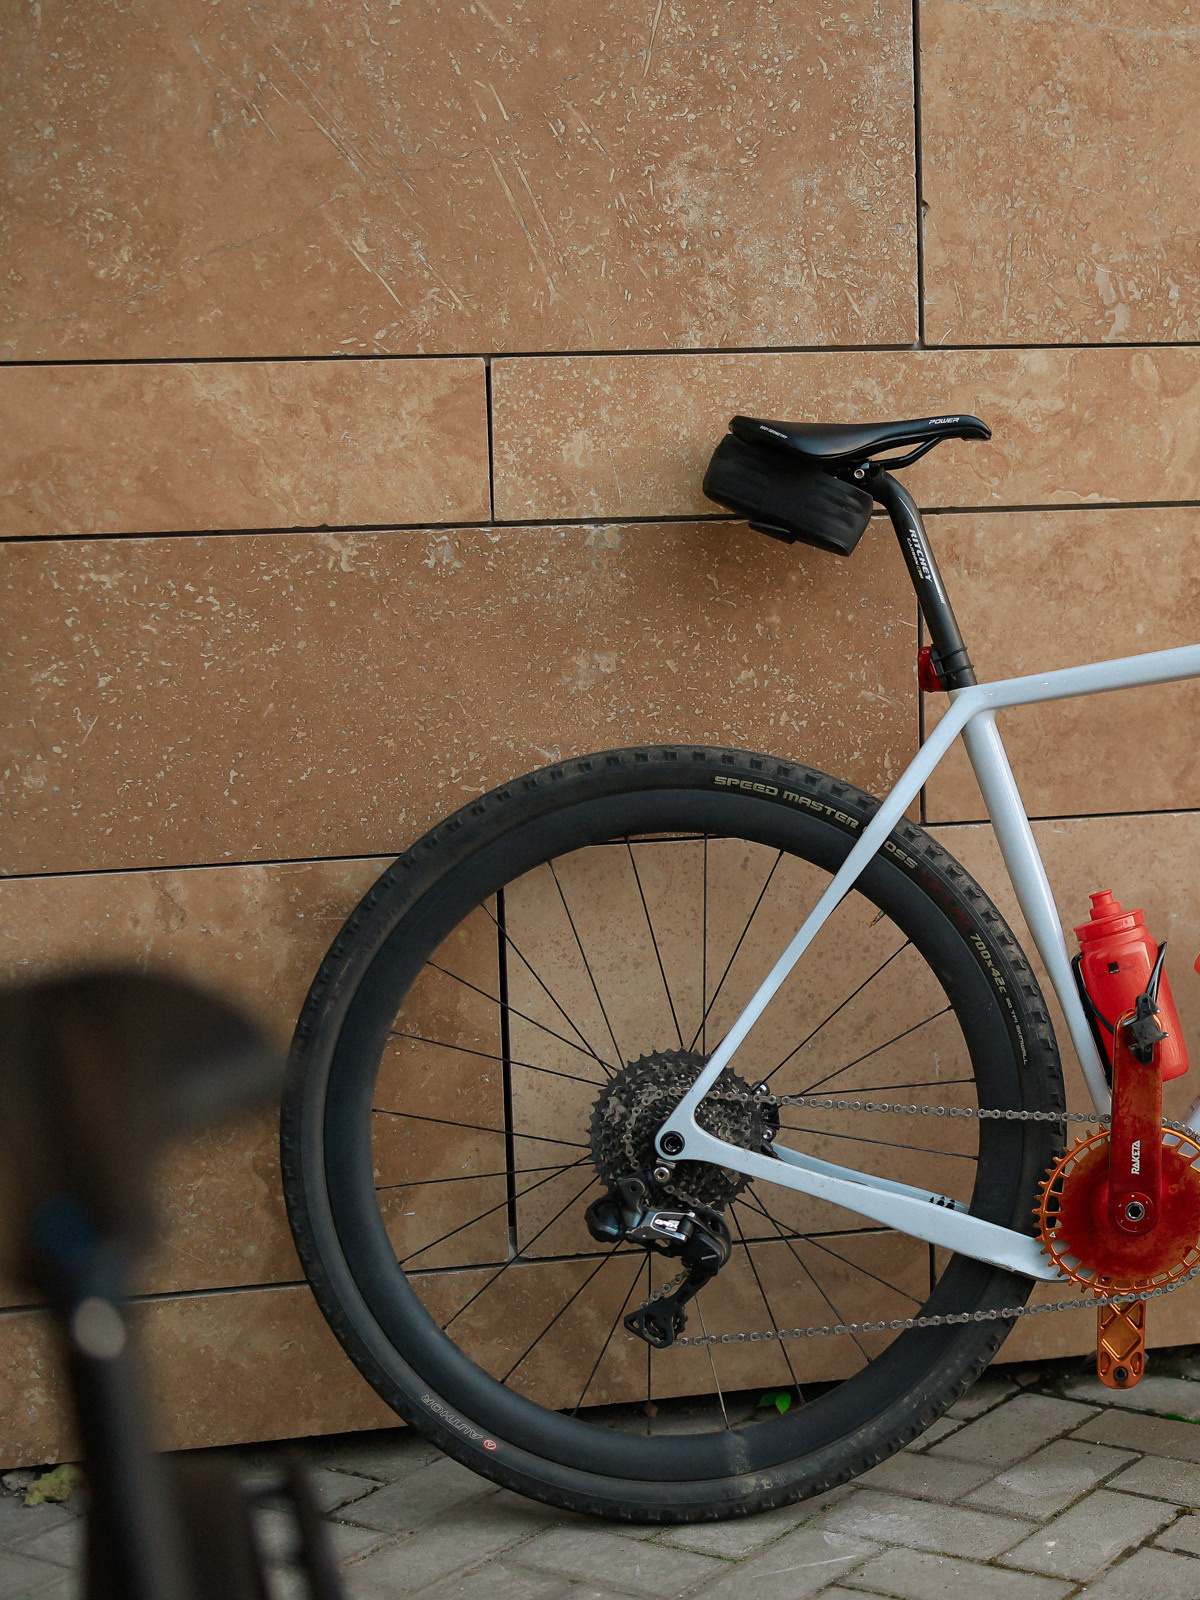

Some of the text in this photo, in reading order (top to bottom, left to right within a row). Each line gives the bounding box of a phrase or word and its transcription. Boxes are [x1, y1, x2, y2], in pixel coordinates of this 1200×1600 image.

[928, 417, 960, 425] POWER
[908, 529, 933, 583] RITCHEY
[714, 775, 779, 797] SPEED
[782, 790, 860, 830] MASTER
[1131, 1140, 1141, 1175] RAKETA
[421, 1393, 484, 1440] AUTHOR
